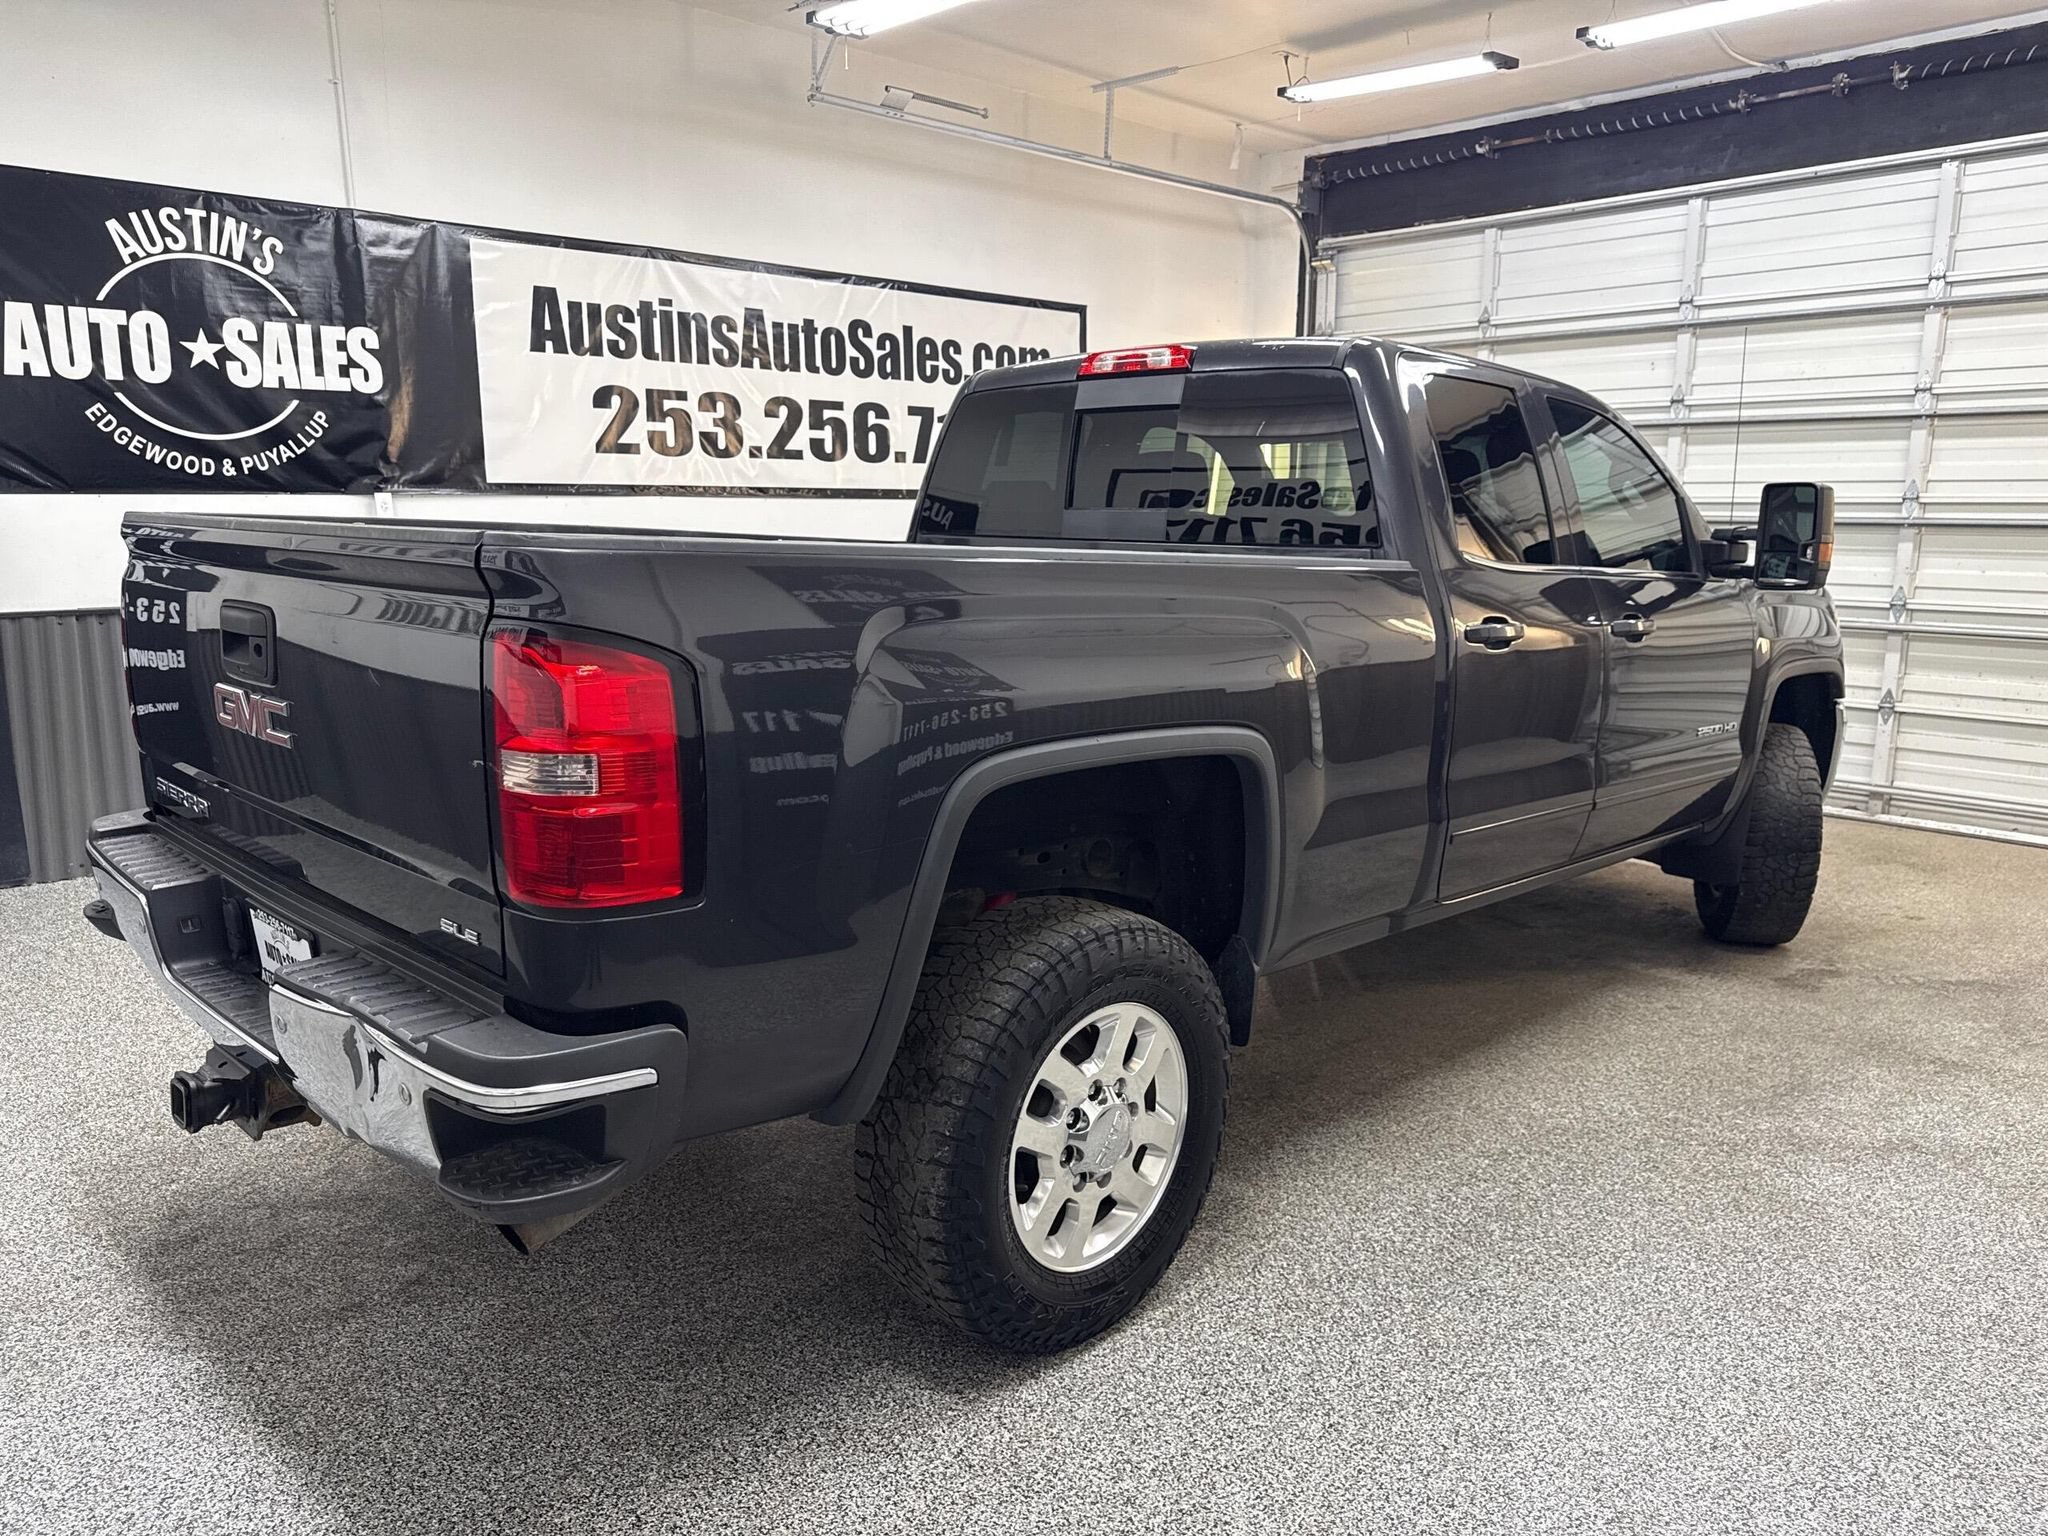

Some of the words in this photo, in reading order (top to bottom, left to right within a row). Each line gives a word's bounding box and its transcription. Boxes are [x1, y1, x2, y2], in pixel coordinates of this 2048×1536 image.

[104, 207, 284, 276] AUSTIN'S
[3, 301, 173, 384] AUTO
[222, 316, 384, 394] SALES
[84, 401, 216, 477] EDGEWOOD
[222, 458, 237, 477] &
[242, 409, 329, 476] PUYALLUP
[592, 384, 946, 464] 253.256.7
[213, 682, 298, 749] GMC
[155, 776, 211, 818] SIERRA
[439, 917, 481, 946] SLE
